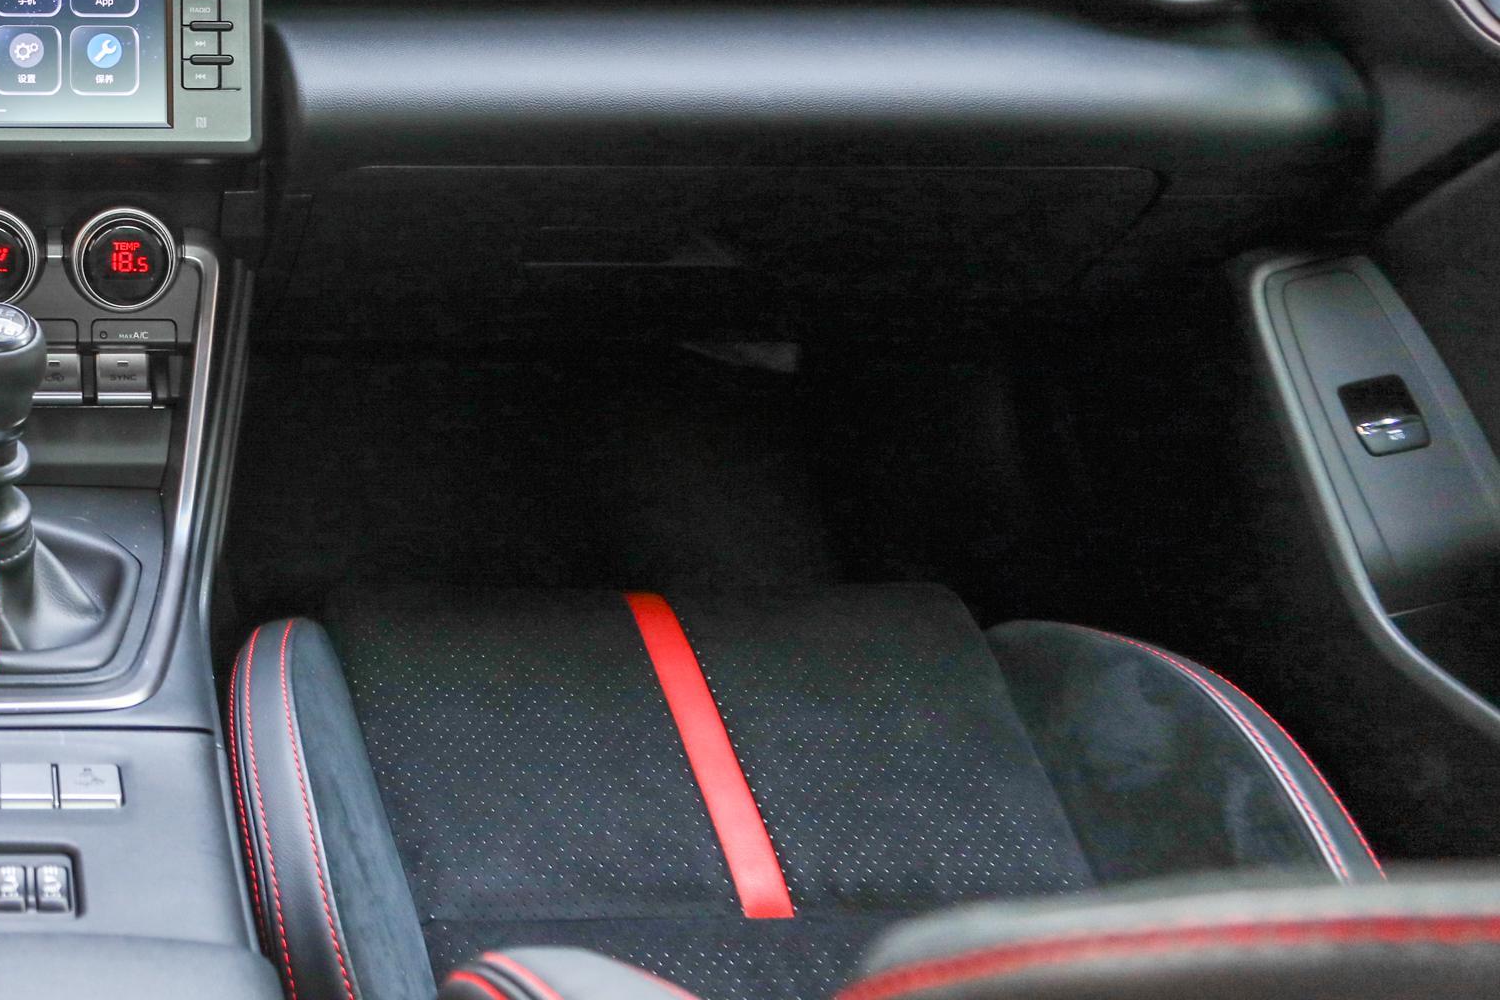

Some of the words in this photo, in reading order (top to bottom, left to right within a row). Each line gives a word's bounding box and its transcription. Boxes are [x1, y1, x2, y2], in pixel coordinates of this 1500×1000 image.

[17, 74, 36, 84] 设置
[95, 74, 114, 84] 保养
[112, 241, 140, 251] TEMP
[112, 251, 149, 272] 18.5
[133, 331, 149, 339] A/C
[109, 373, 137, 381] SYNC
